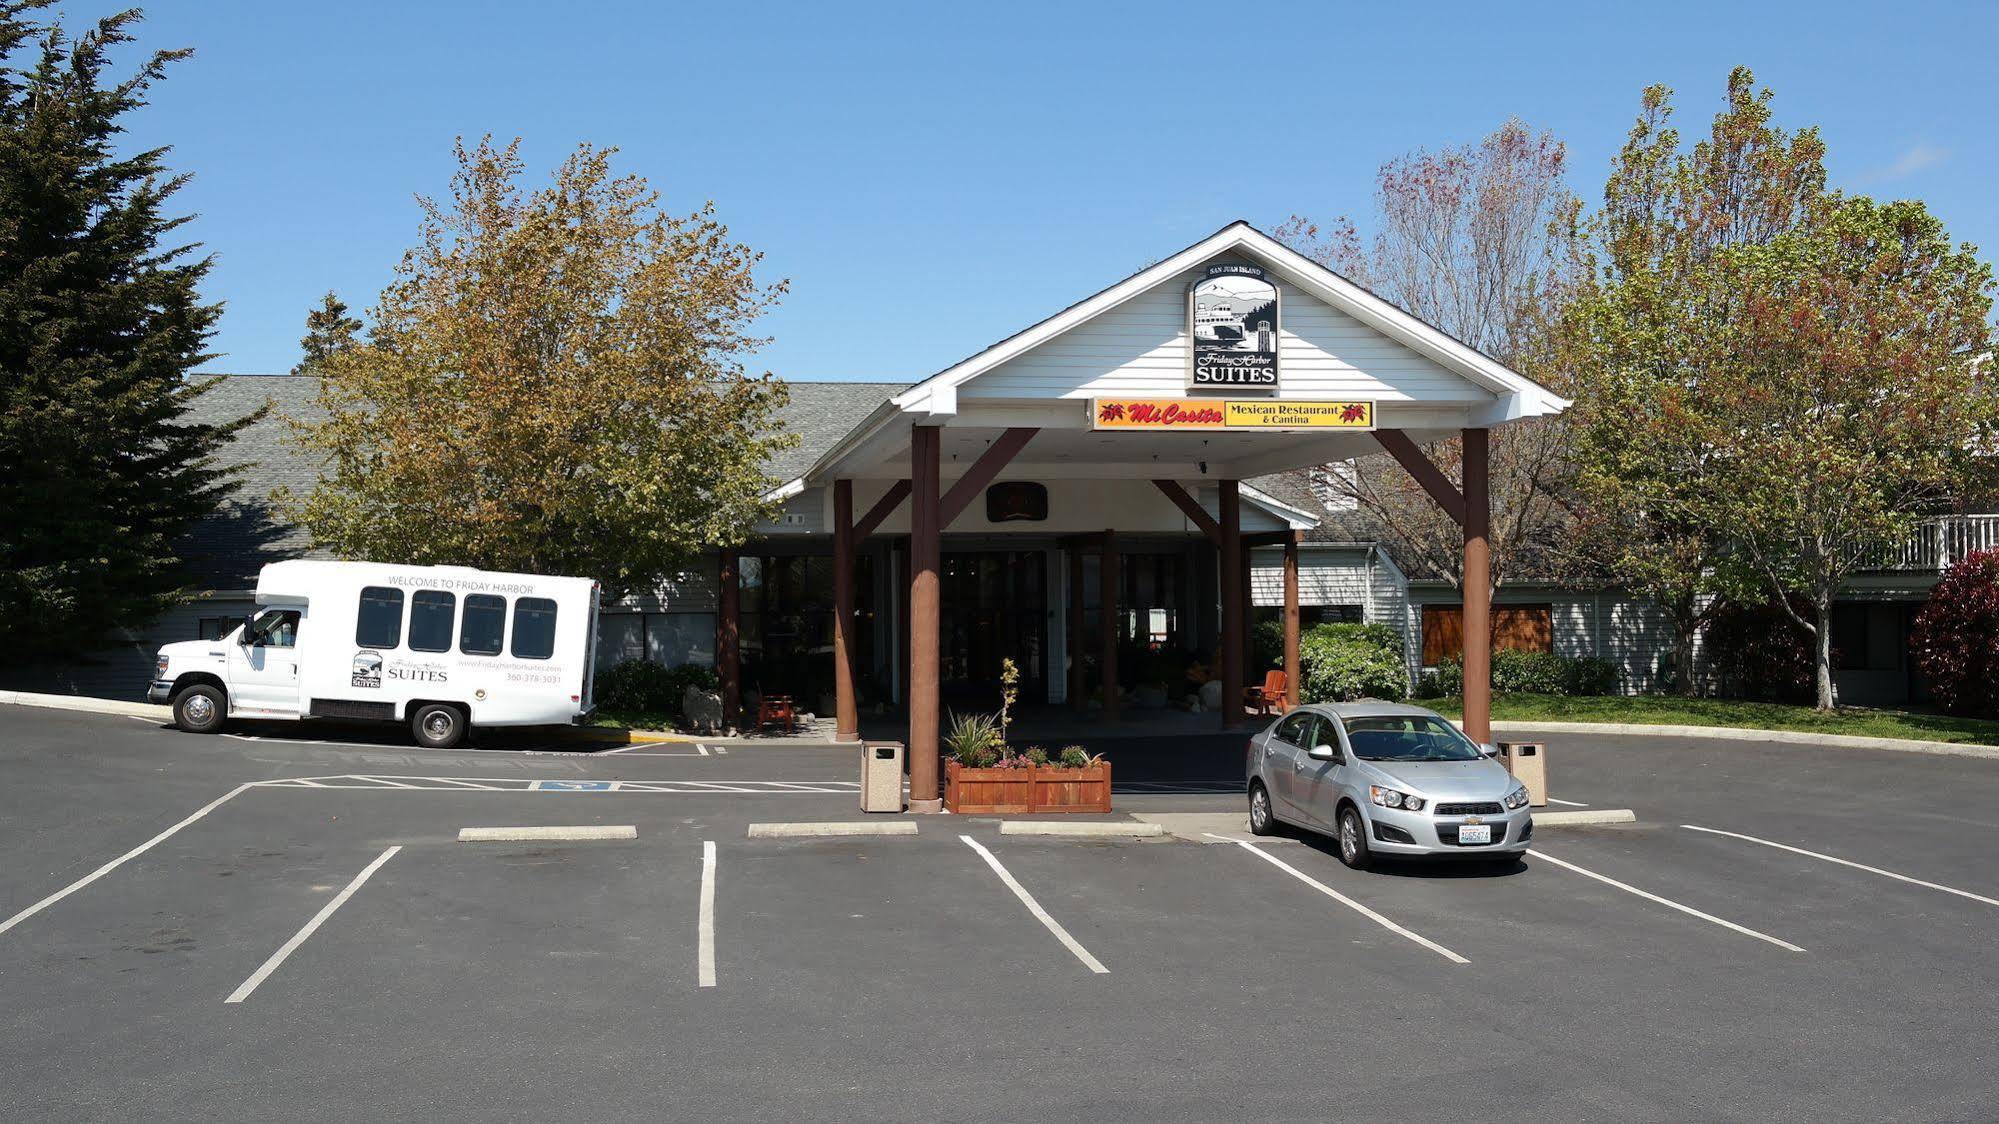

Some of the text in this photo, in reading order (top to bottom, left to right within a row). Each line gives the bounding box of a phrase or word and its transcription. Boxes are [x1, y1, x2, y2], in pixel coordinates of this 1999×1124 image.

[1209, 267, 1222, 275] SAN
[1239, 266, 1261, 276] ISLAND
[1198, 353, 1271, 366] Friday Harbor
[1196, 367, 1275, 383] SUITES
[1231, 404, 1339, 416] Mexican Restaurant
[1262, 415, 1309, 424] & Cantina
[388, 576, 534, 595] WELCOME TO FRIDAY HARBOR
[388, 668, 448, 682] SUITES
